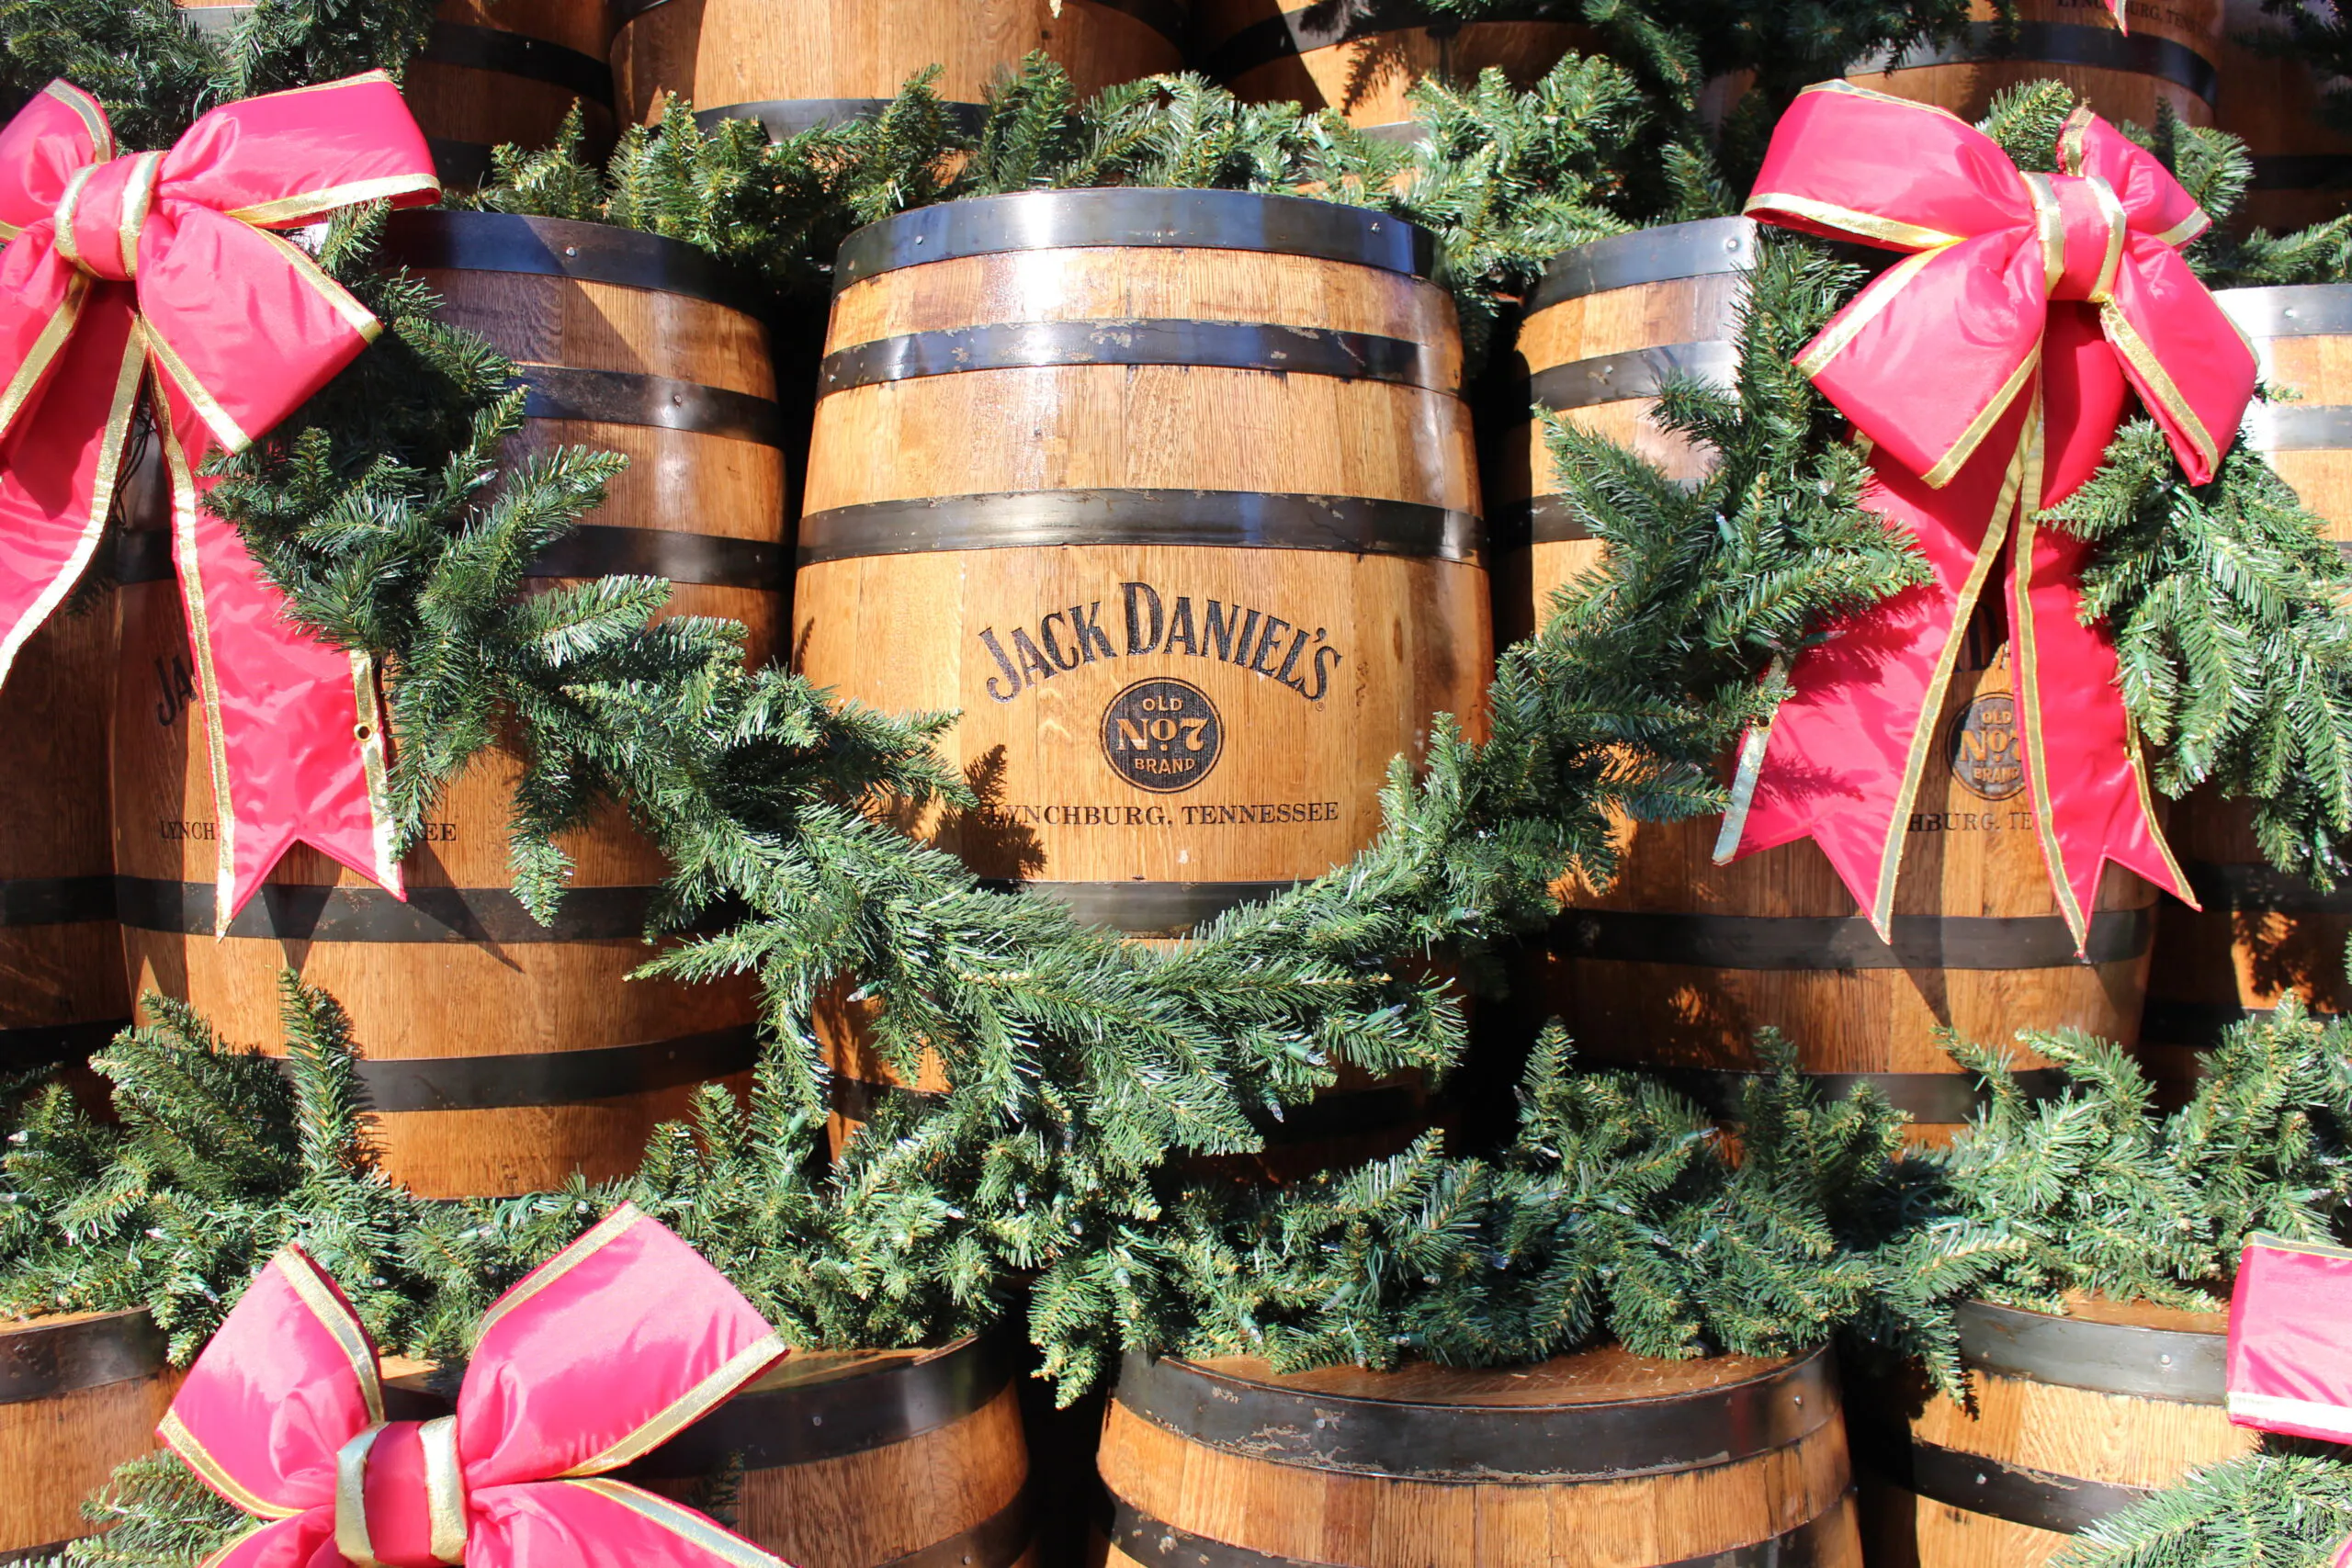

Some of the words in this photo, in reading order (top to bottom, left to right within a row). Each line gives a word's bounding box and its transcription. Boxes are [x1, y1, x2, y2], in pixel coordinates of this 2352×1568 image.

[978, 602, 1117, 704] JACK
[1119, 582, 1343, 702] DANIEL'S
[154, 654, 197, 726] JA
[1142, 695, 1183, 712] OLD
[1982, 710, 2012, 725] OLD
[1135, 758, 1195, 774] BRAND
[1182, 802, 1339, 825] TENNESSEE
[160, 820, 217, 840] LYNCH
